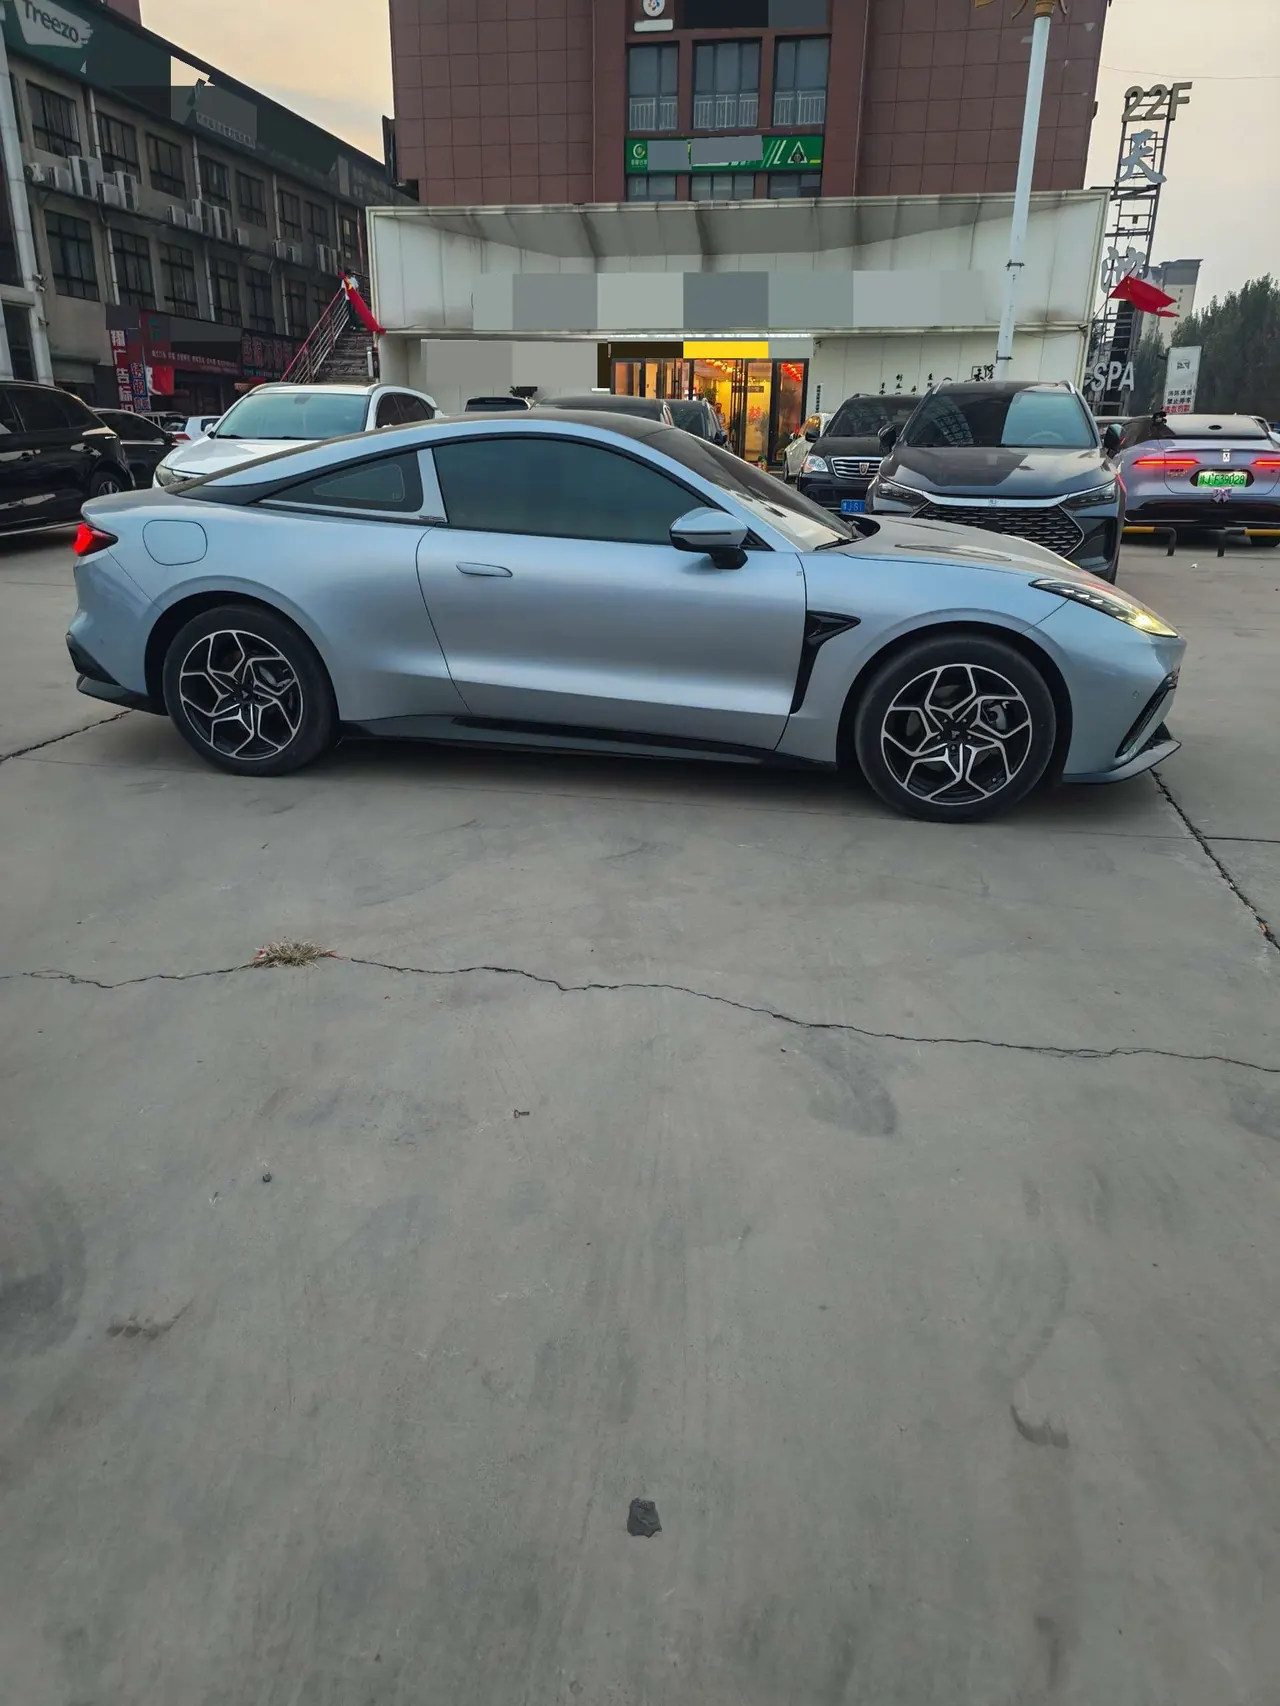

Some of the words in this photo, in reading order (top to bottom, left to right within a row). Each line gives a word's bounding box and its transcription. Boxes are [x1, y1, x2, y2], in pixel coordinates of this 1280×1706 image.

[23, 0, 79, 43] Treezo
[1121, 82, 1193, 122] 22F
[1091, 361, 1134, 391] SPA
